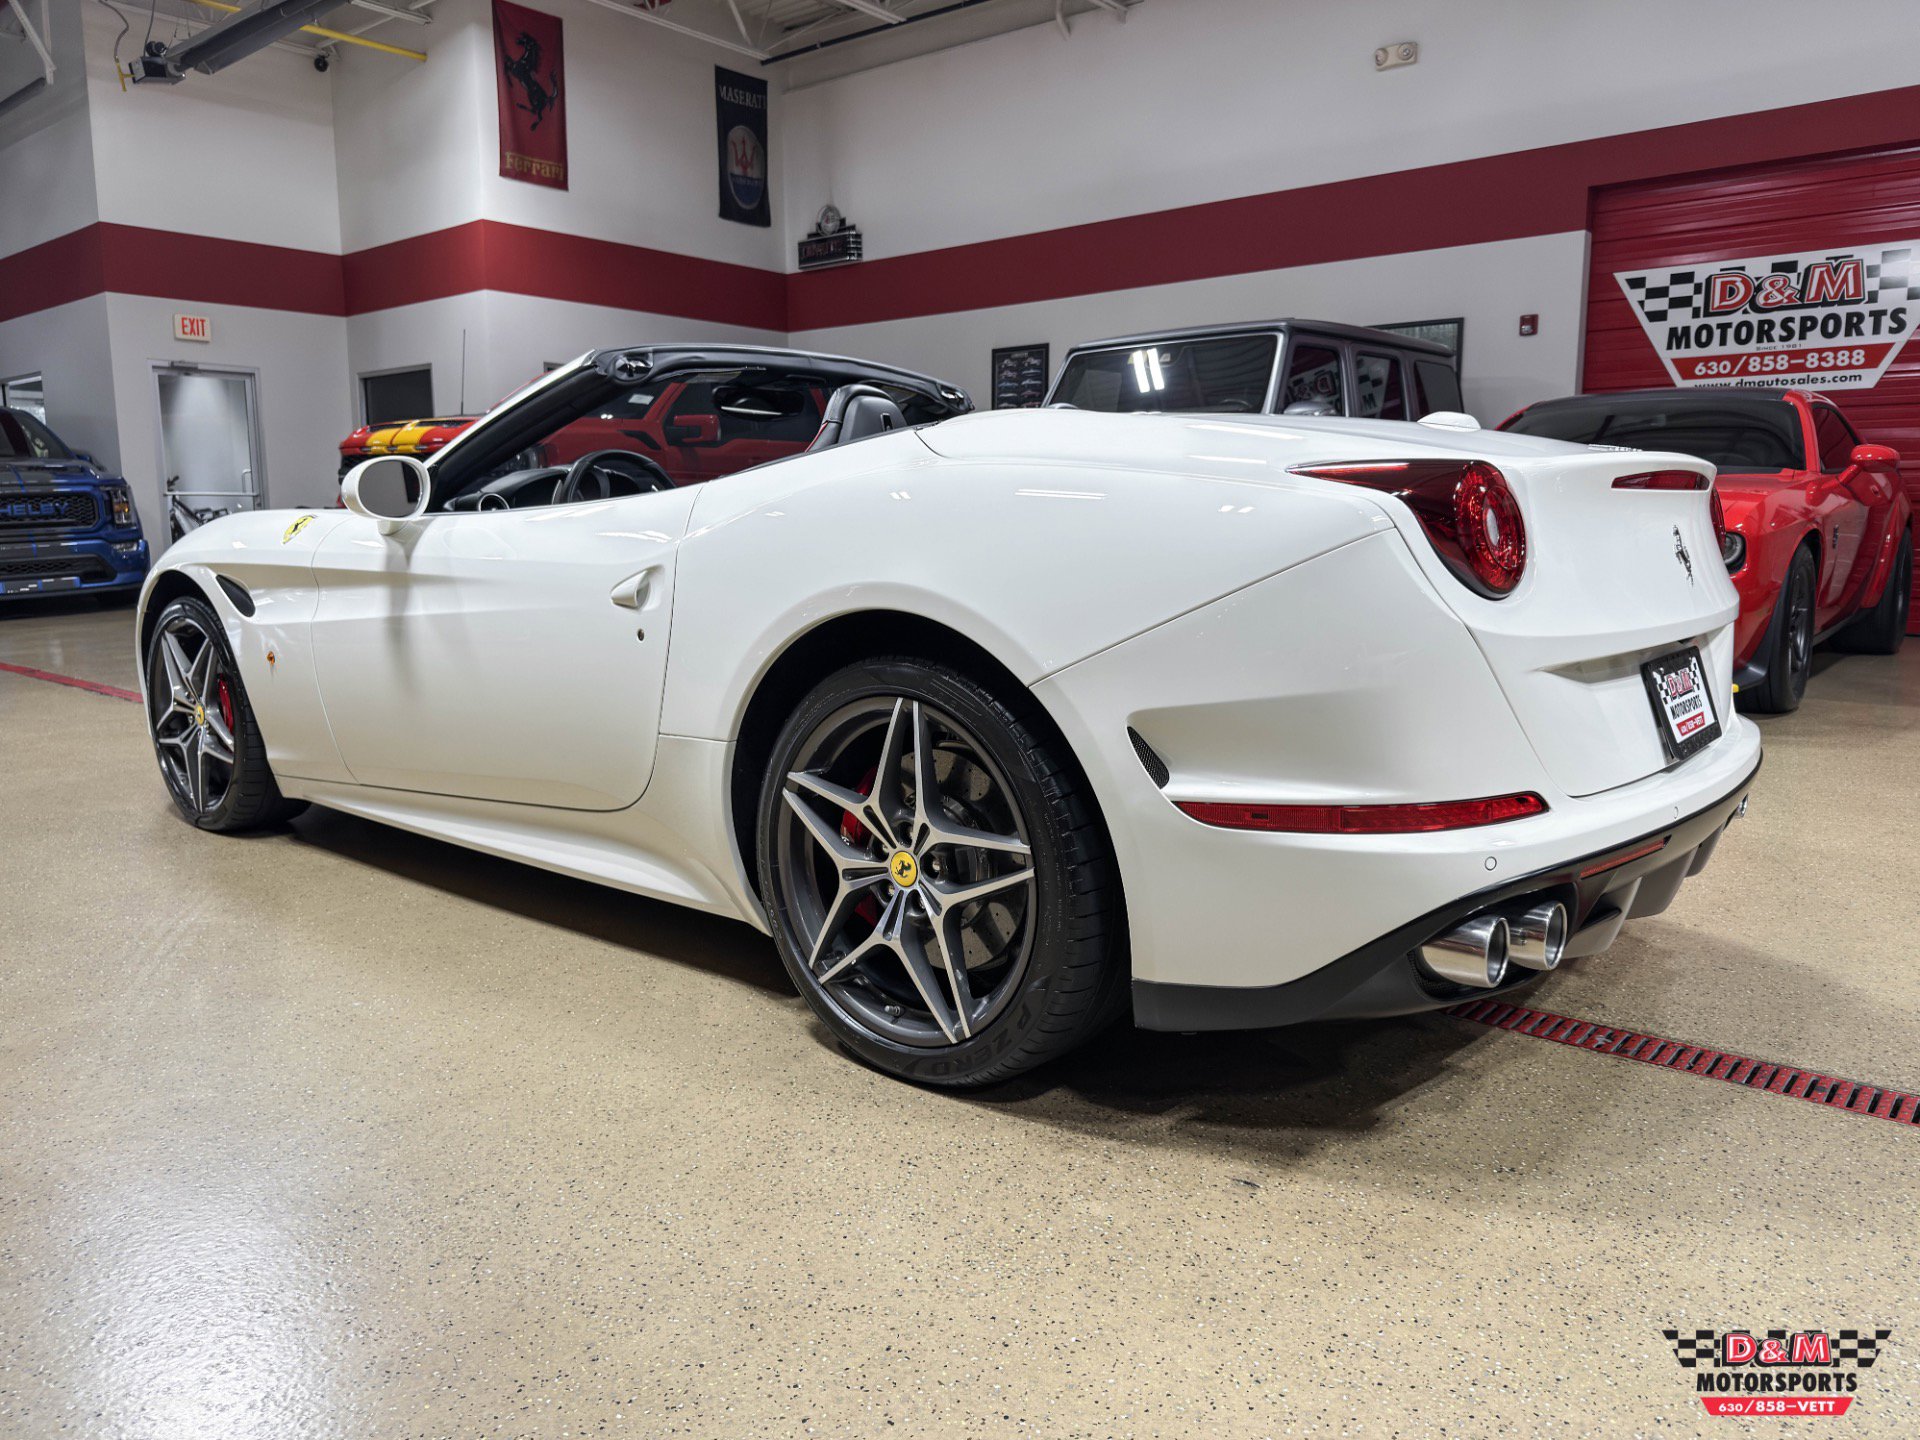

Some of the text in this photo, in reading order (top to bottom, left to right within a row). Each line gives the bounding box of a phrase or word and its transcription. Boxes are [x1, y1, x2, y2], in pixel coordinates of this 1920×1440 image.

[505, 151, 564, 181] Ferrari
[1706, 259, 1865, 316] D&M
[181, 316, 206, 337] EXIT
[1666, 307, 1907, 350] MOTORSPORTS
[1694, 349, 1866, 375] 630/858-8388
